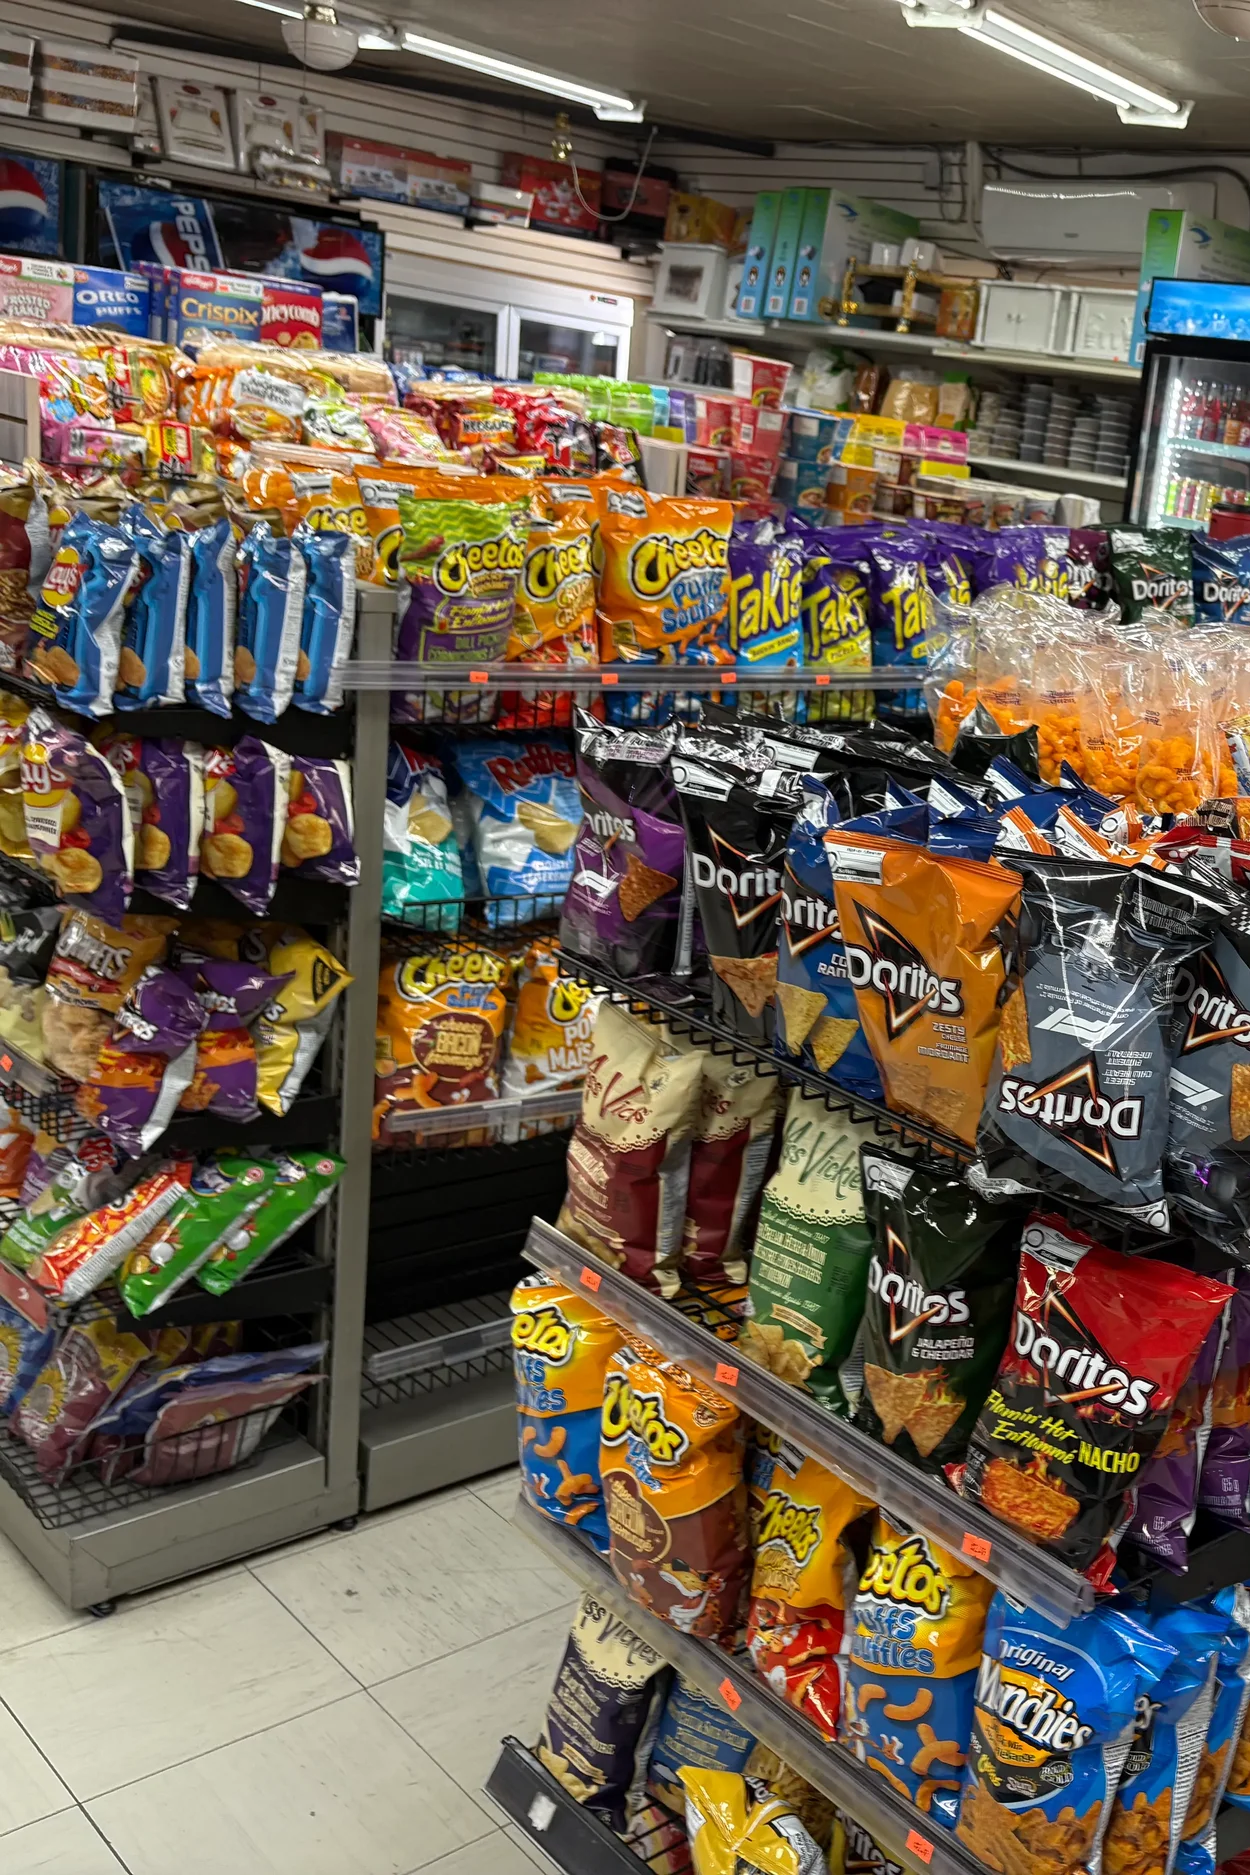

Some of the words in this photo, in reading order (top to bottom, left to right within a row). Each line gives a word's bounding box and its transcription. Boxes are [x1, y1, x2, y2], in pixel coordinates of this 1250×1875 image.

[170, 200, 212, 272] PEPS
[76, 288, 140, 305] OREO
[96, 304, 142, 317] PUFFS
[181, 298, 259, 326] Crispix
[729, 568, 802, 652] Takis
[691, 852, 785, 898] Dorit
[816, 963, 849, 979] RAN
[844, 946, 961, 1014] Doritos
[931, 1021, 967, 1036] ZESTY
[916, 1045, 971, 1064] MORDANT
[1000, 1079, 1145, 1140] Doritos
[868, 1254, 971, 1327] Doritos
[916, 1335, 975, 1349] JALAPEÑO
[919, 1348, 975, 1361] CHEDDAR
[1015, 1310, 1156, 1416] Doritos
[984, 1389, 1041, 1425] Flamin'
[1038, 1416, 1079, 1441] Hot
[990, 1419, 1079, 1465] Enflammé
[1078, 1440, 1141, 1474] NACHO
[759, 1495, 819, 1560] heetos
[998, 1637, 1076, 1683] Original
